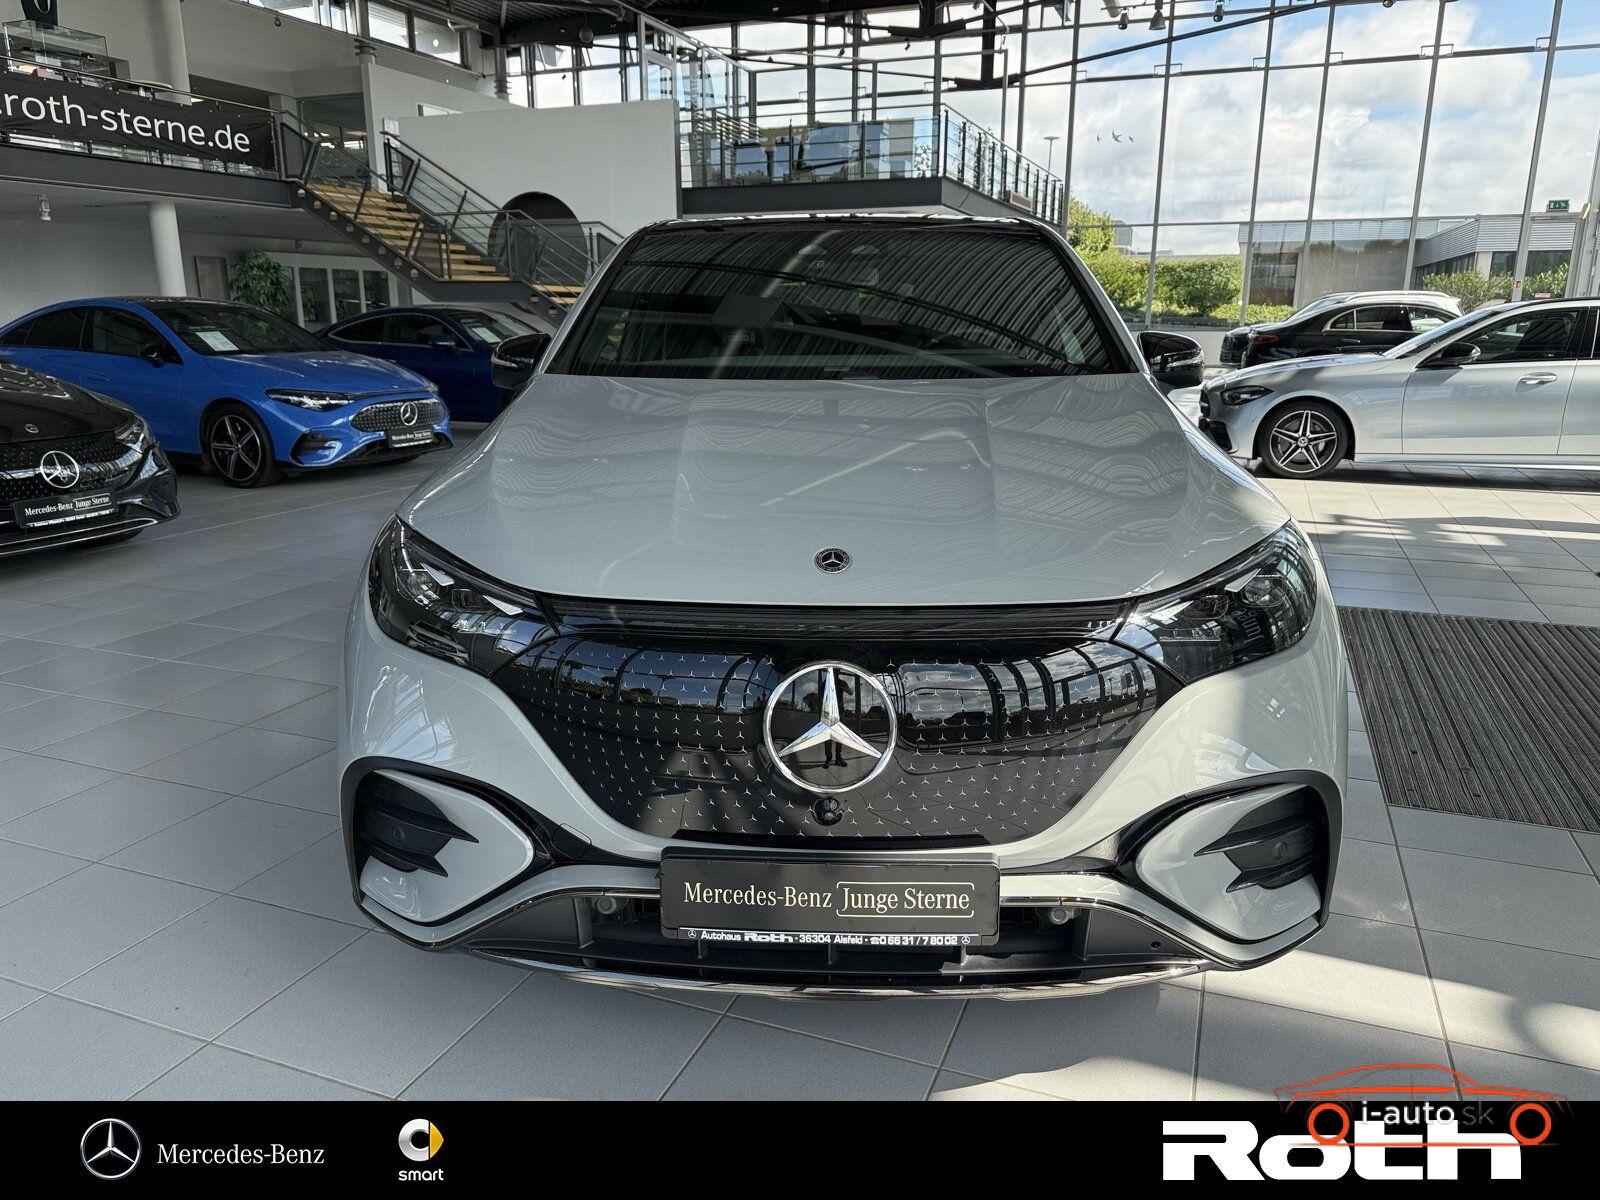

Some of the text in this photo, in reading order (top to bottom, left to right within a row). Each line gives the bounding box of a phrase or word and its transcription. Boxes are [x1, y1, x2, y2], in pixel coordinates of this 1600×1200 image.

[24, 502, 74, 517] Mercedes-Benz
[683, 882, 970, 914] Mercedes-Benz Junge Sterne
[700, 930, 741, 942] Autohaus
[744, 933, 793, 943] Roth
[799, 934, 831, 944] 36304
[833, 935, 863, 945] Alsfeld
